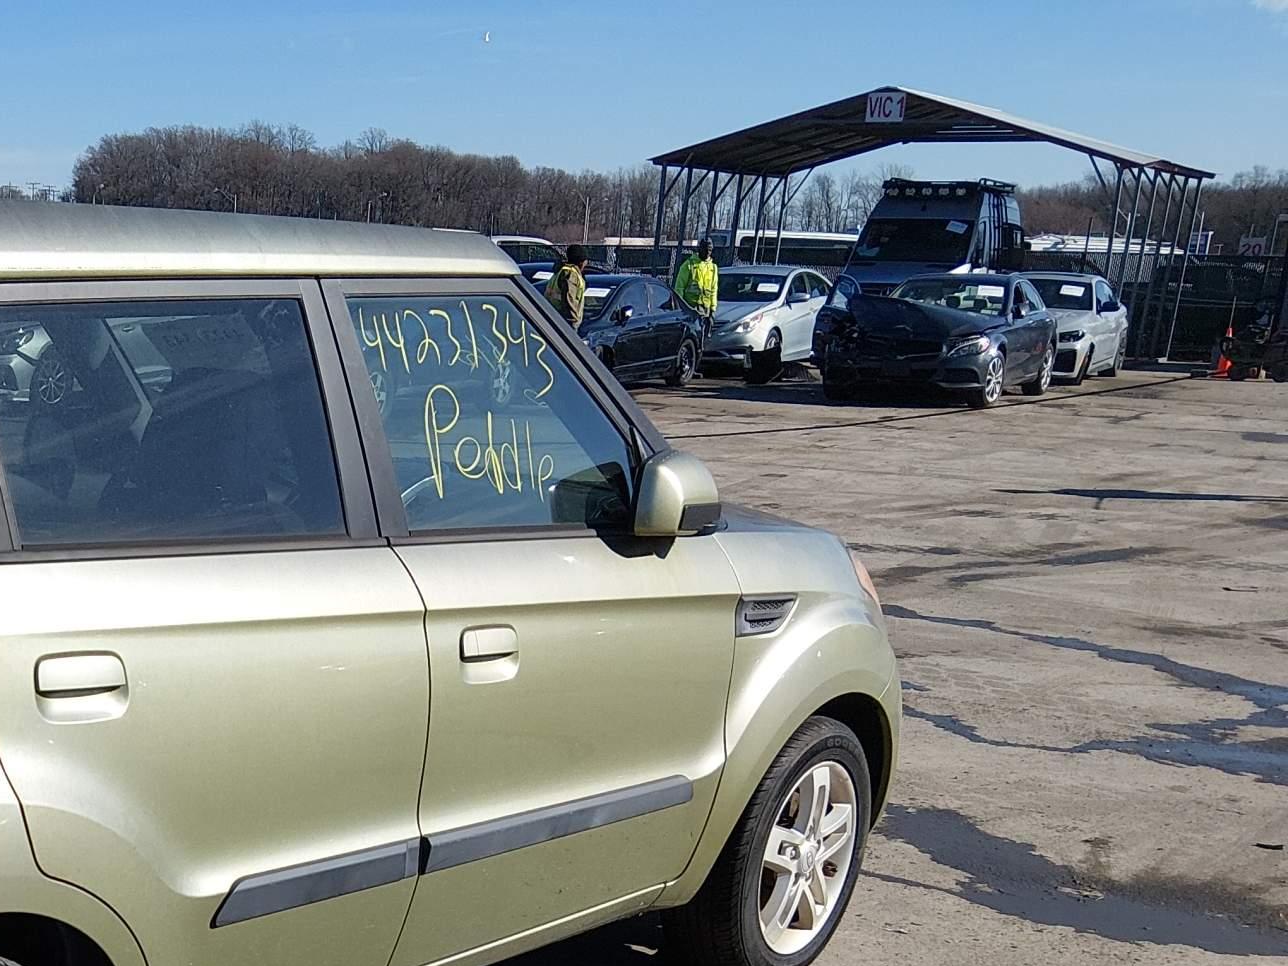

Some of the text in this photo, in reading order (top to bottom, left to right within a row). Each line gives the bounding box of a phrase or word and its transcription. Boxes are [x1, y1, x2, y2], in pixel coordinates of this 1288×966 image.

[869, 96, 905, 118] VIC 1
[1241, 242, 1262, 256] 20
[359, 300, 554, 398] 44231343
